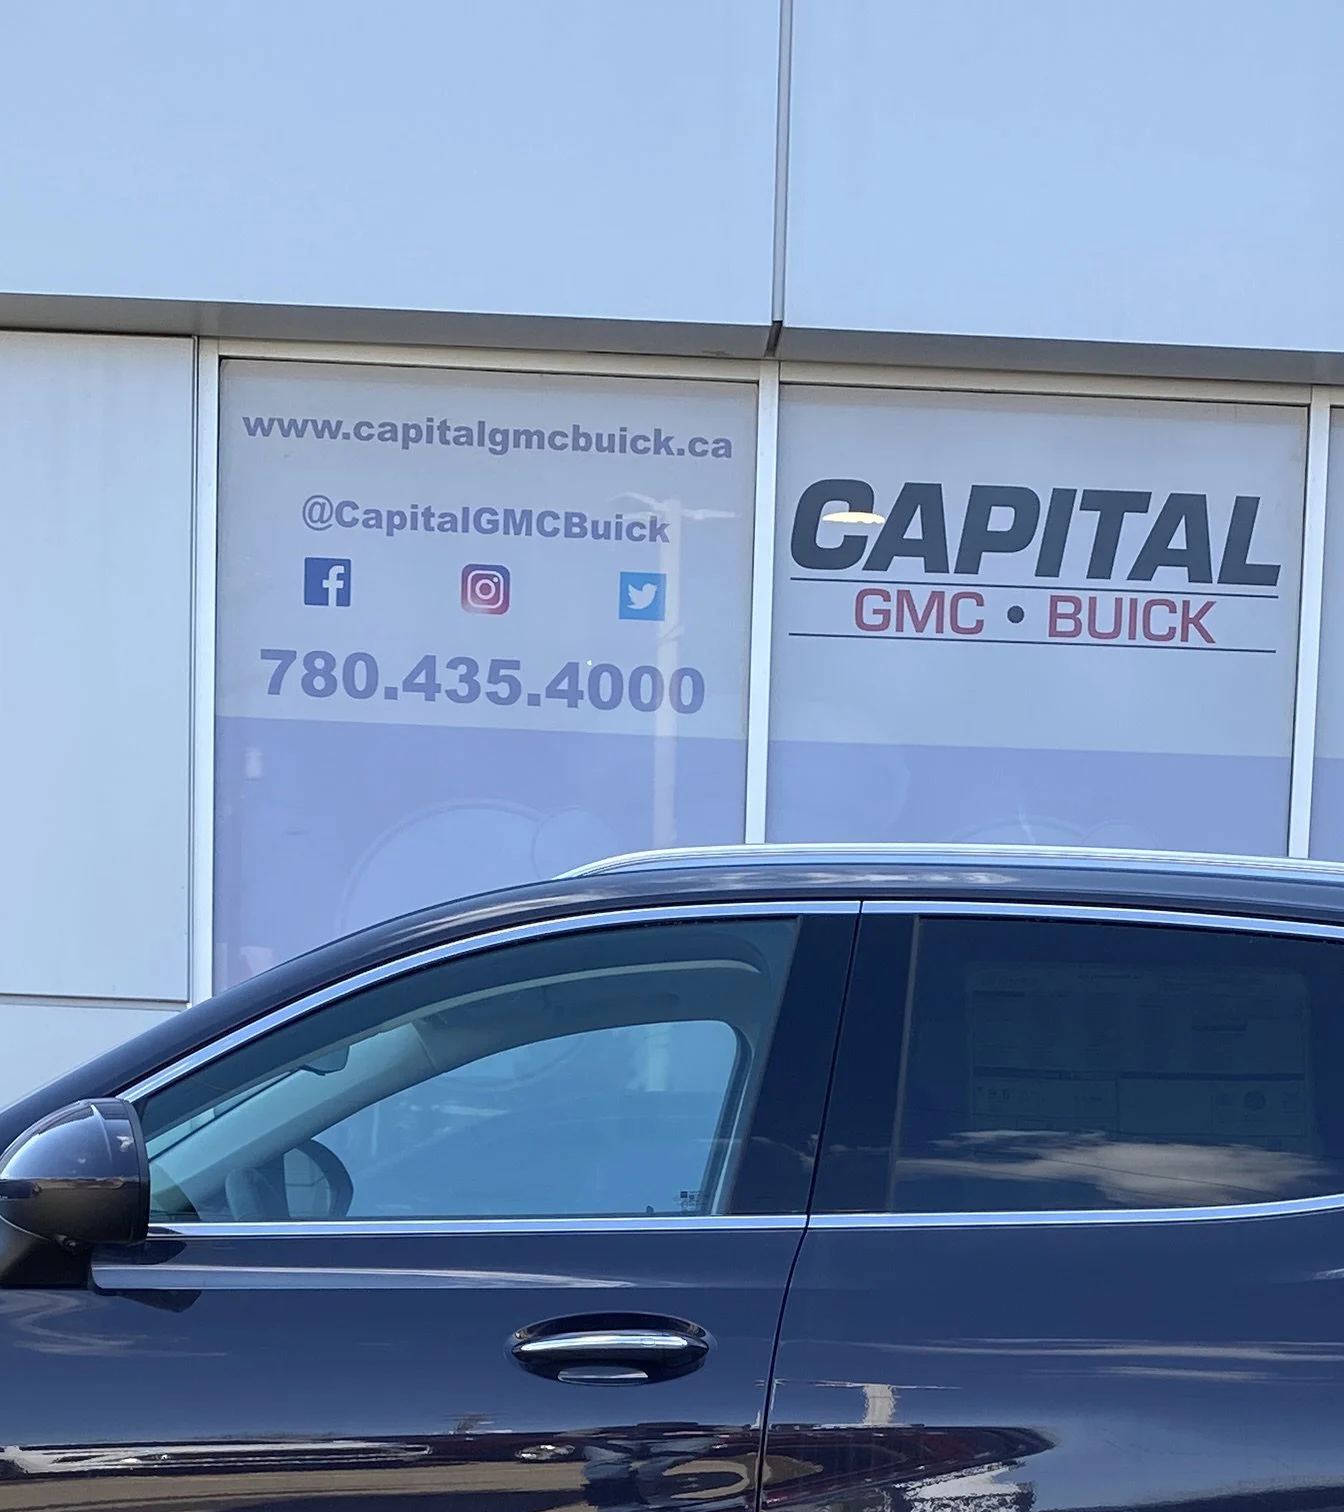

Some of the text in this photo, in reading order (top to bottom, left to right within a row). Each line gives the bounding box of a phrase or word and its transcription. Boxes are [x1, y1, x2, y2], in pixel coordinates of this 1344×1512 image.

[242, 416, 733, 459] www.capitalgmcbuick.ca
[301, 494, 670, 543] @CapitalGMCBuick
[789, 478, 1282, 587] CAPITAL
[854, 587, 1217, 644] GMC BUICK
[260, 647, 706, 715] 780.435.4000
